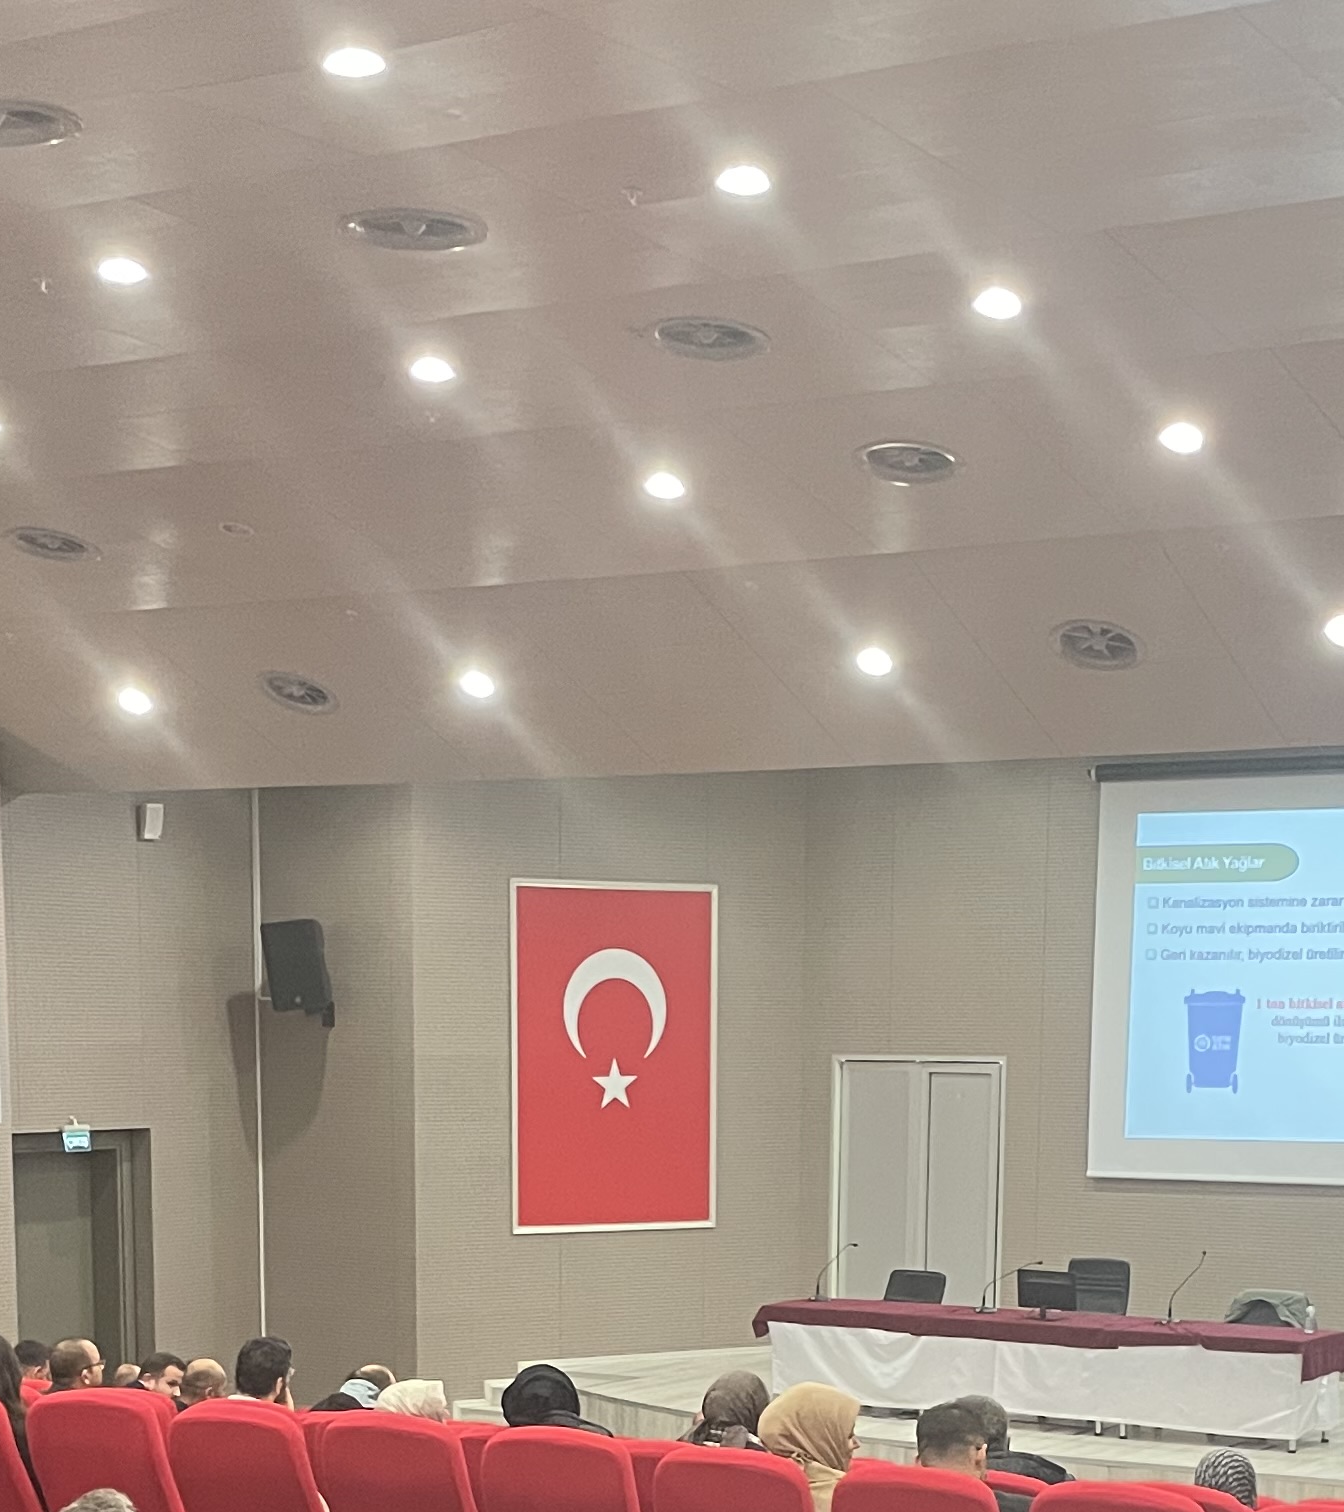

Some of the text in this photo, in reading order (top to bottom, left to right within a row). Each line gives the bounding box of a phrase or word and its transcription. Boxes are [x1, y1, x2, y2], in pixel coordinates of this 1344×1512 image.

[1223, 855, 1266, 872] Yağlar
[1311, 897, 1344, 907] zarar
[1161, 922, 1193, 938] Koyu
[1196, 922, 1226, 934] mavi
[1228, 922, 1298, 936] ekipmanda
[1248, 948, 1303, 963] biyodizel
[1278, 1032, 1330, 1046] biyodizel
